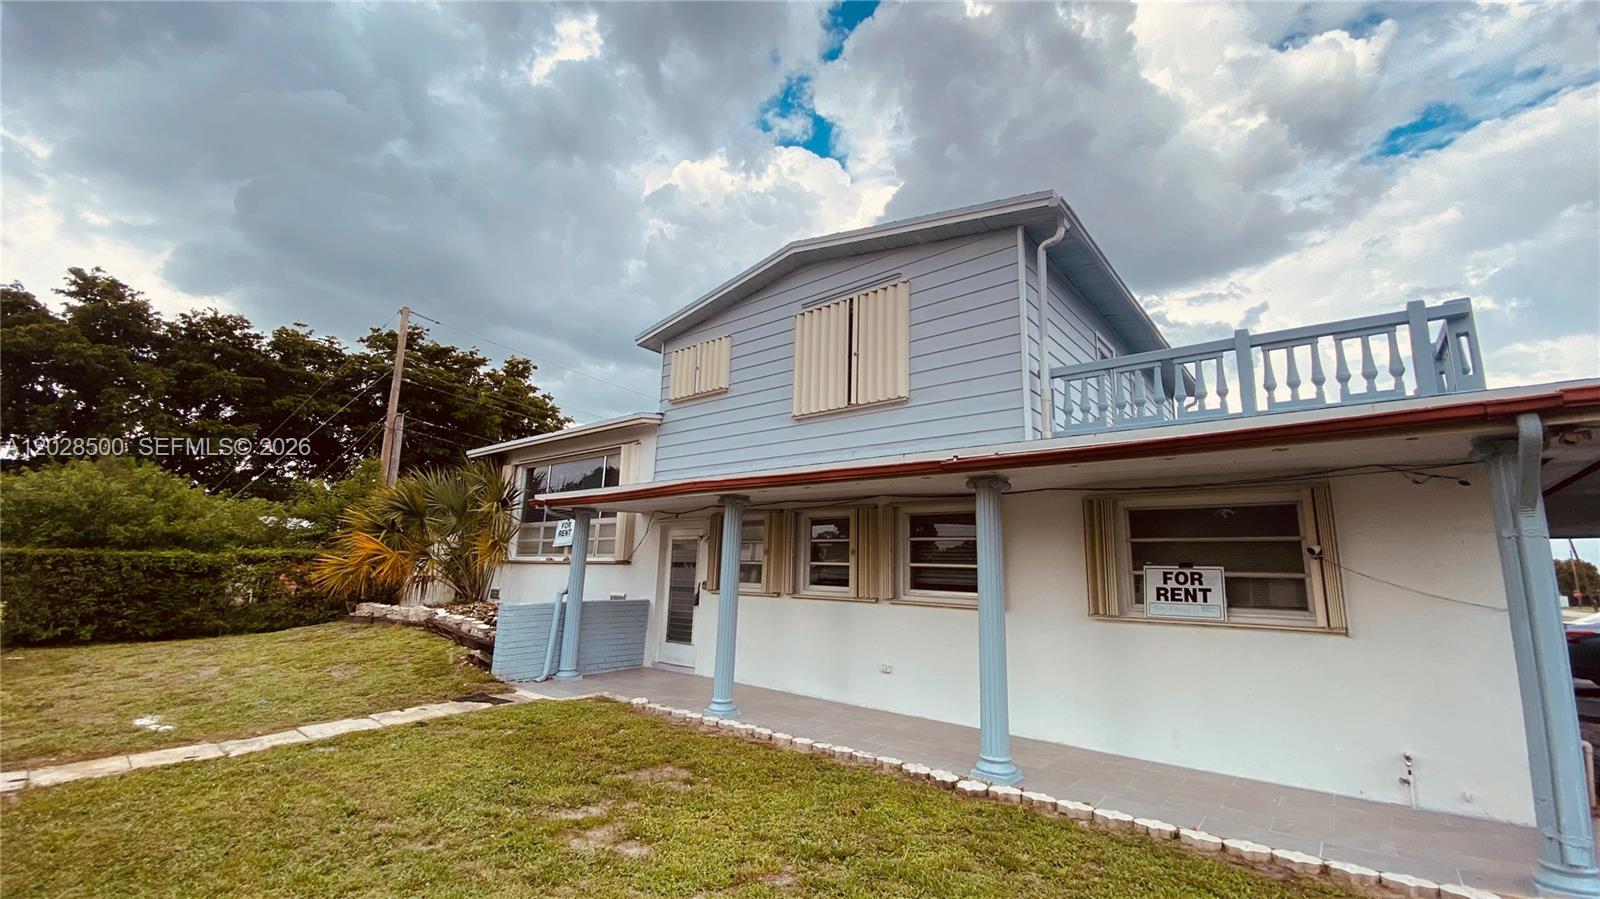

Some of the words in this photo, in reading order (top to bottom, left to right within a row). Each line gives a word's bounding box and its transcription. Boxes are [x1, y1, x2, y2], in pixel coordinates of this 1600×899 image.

[561, 521, 572, 529] FOR
[558, 529, 572, 537] RENT
[1162, 571, 1204, 586] FOR
[1156, 586, 1212, 603] RENT
